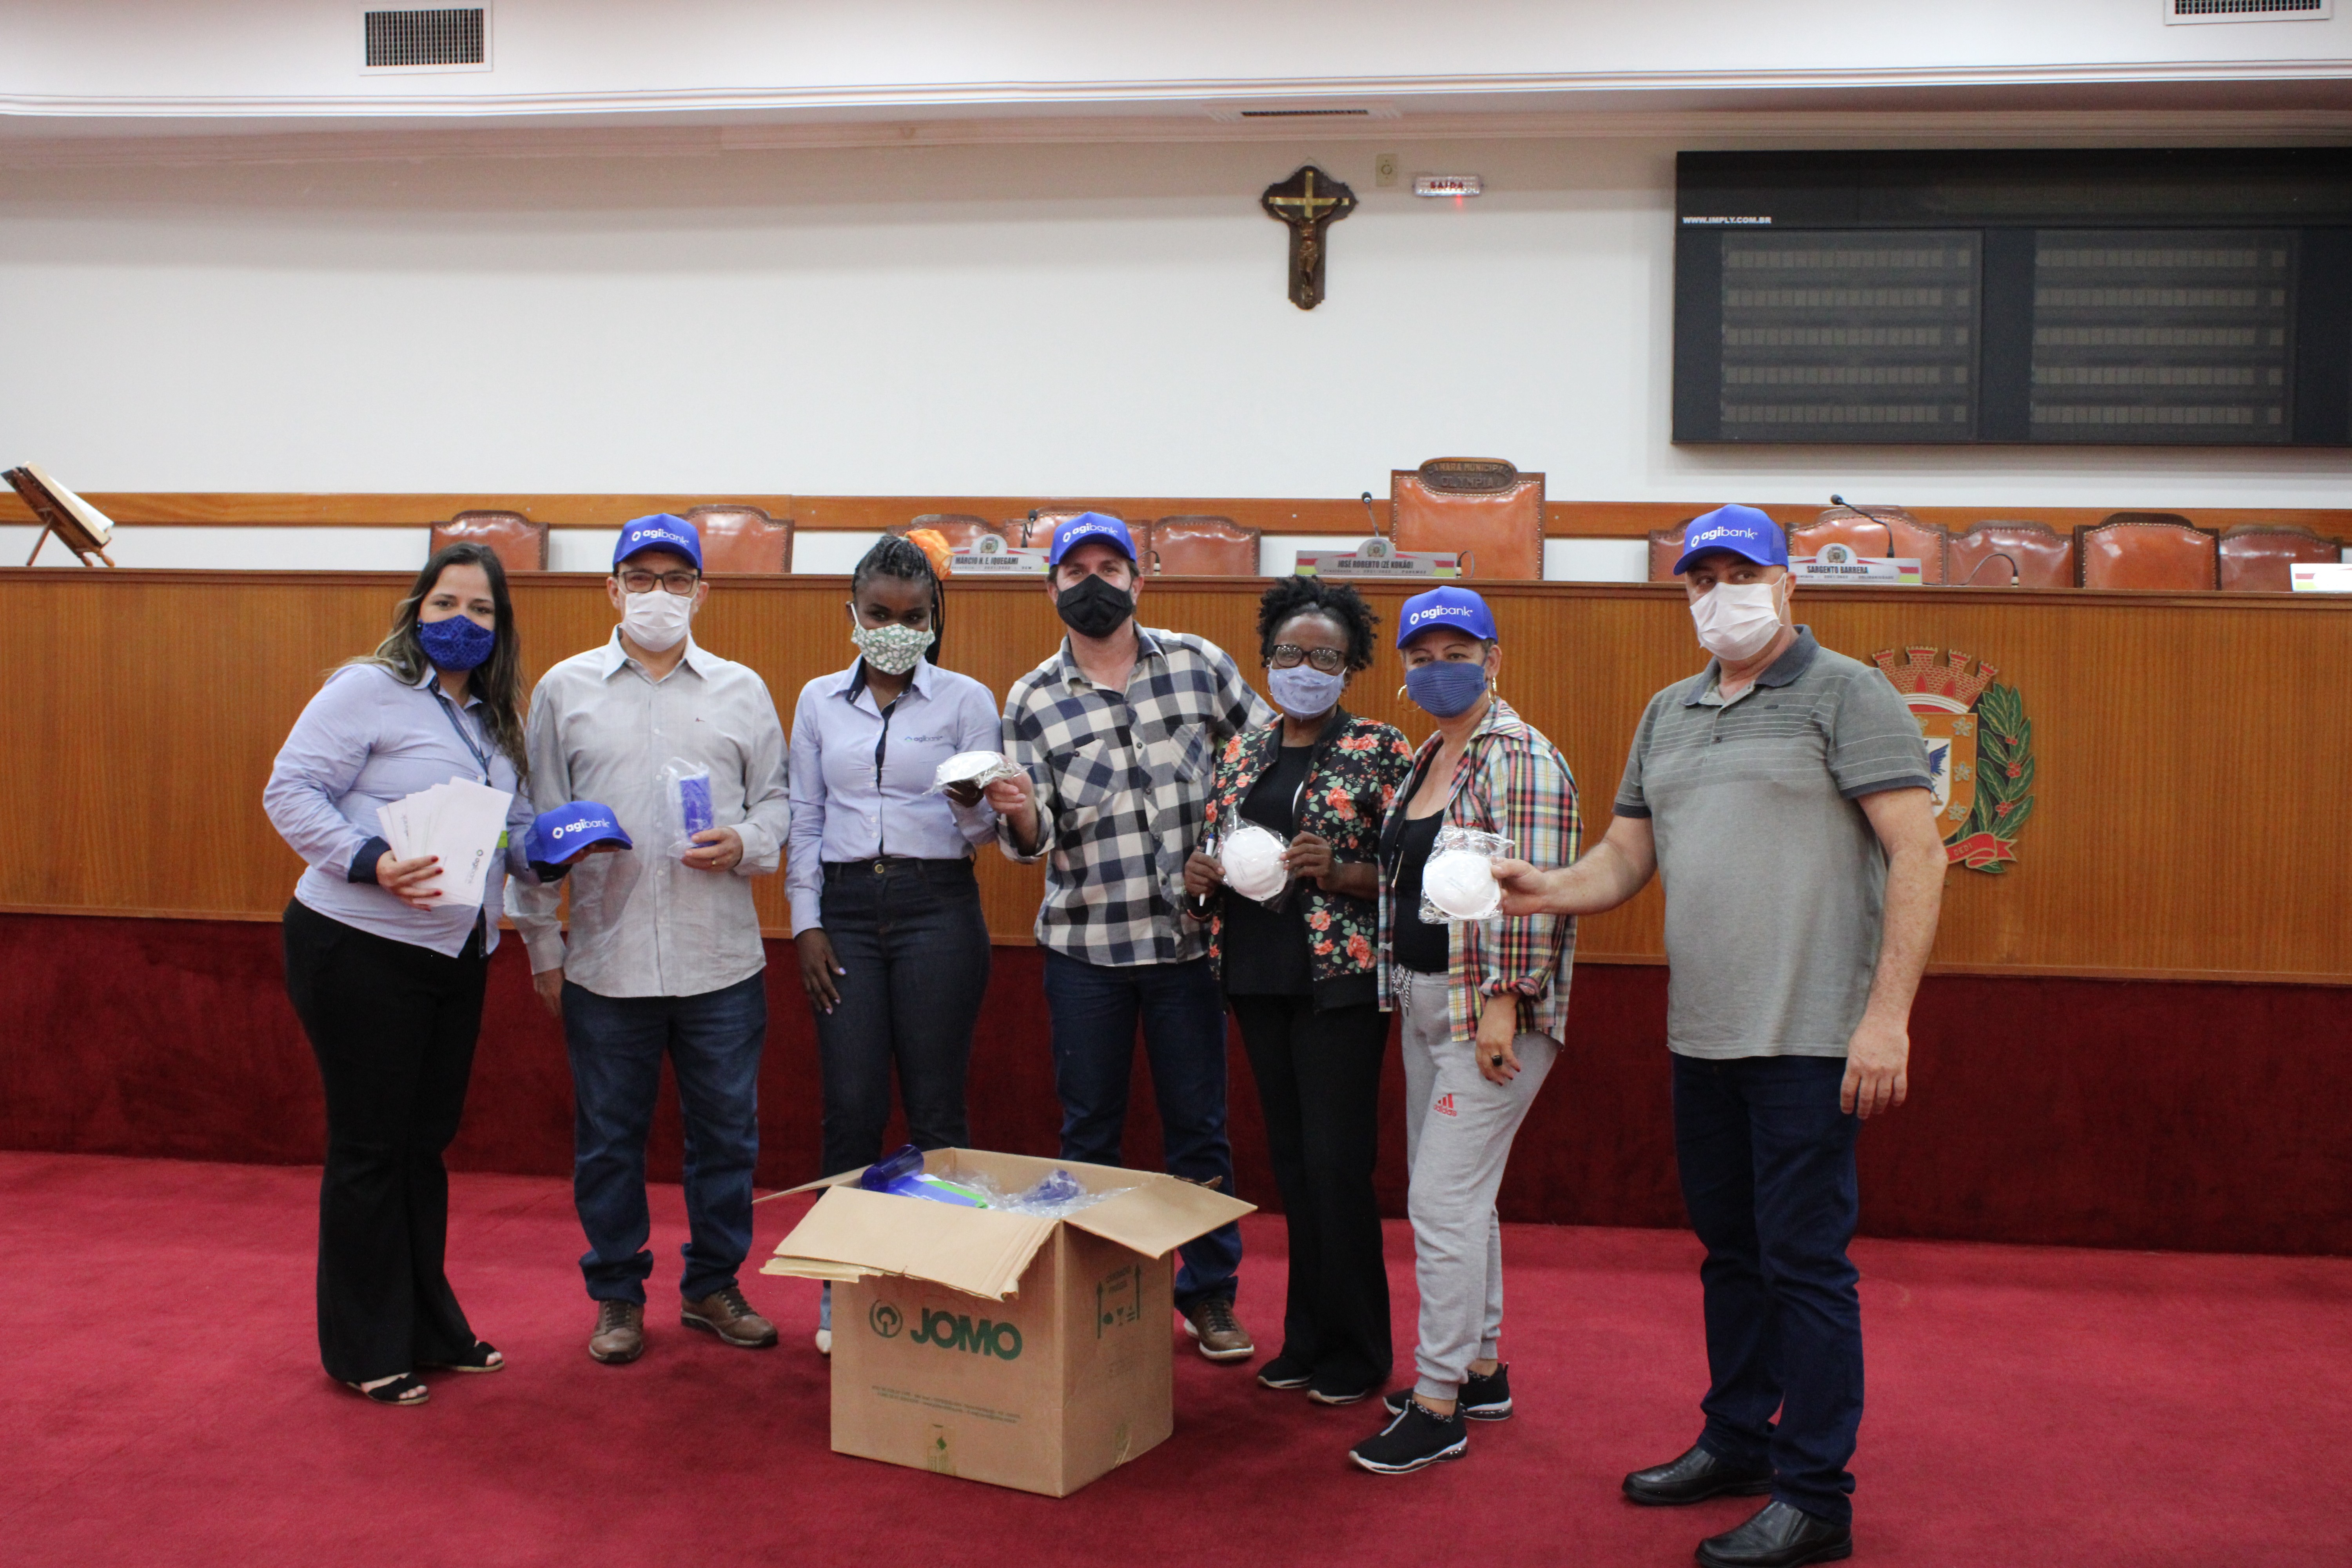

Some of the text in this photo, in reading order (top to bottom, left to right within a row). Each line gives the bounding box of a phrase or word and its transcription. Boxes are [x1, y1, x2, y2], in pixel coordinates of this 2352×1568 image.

[642, 528, 687, 546] agibank
[1700, 526, 1755, 540] agibank
[1338, 559, 1352, 568] JOSÉ
[1421, 605, 1471, 619] agibank
[565, 818, 610, 832] agibank
[1433, 1104, 1457, 1117] adidas
[909, 1307, 1023, 1361] JOMO
